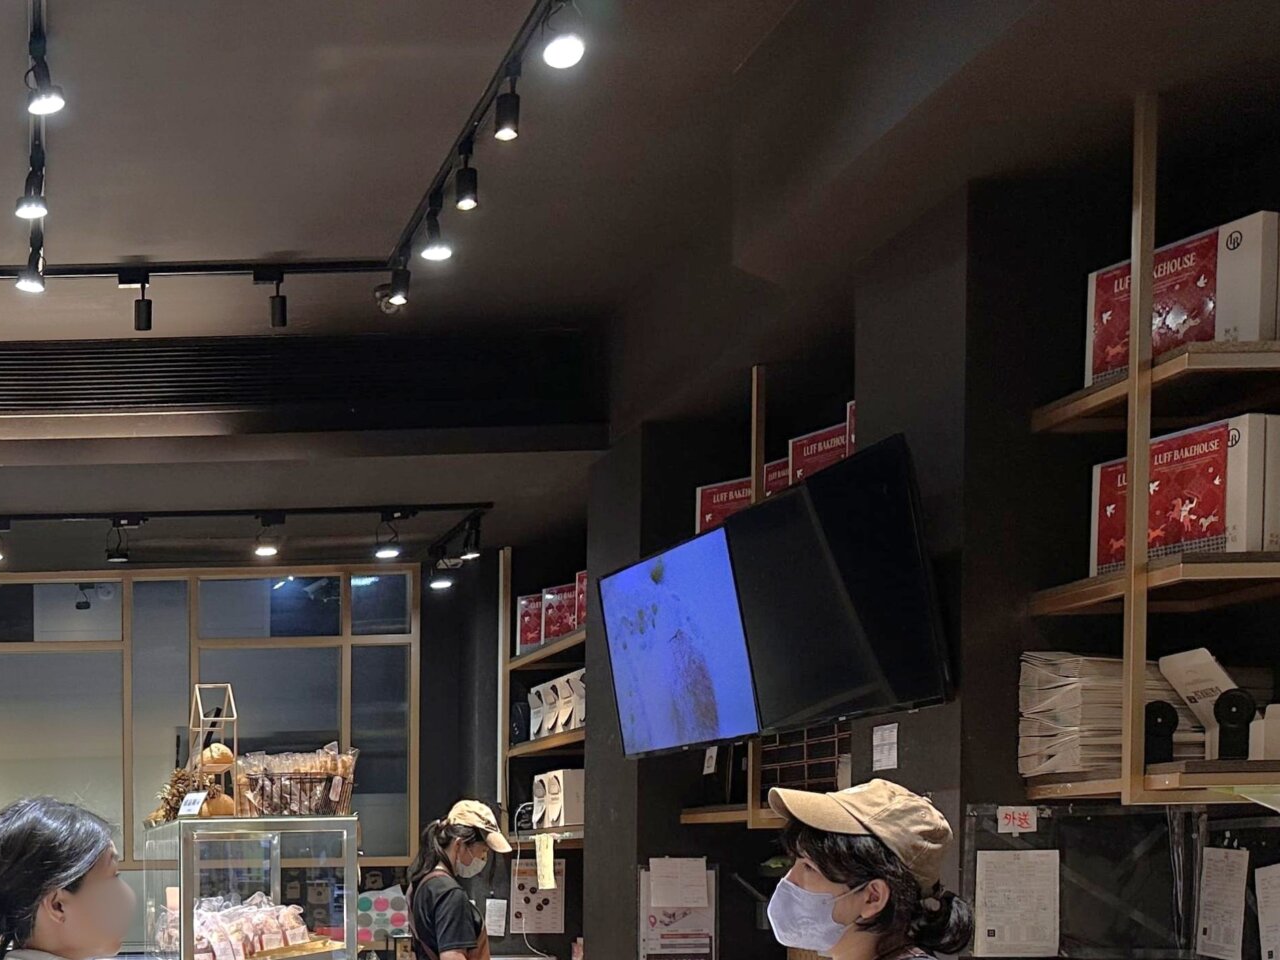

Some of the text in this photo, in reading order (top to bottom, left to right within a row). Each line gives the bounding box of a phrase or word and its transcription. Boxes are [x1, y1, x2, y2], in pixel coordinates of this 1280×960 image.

[1114, 252, 1197, 293] LUF KEHOUSE
[804, 435, 847, 457] LUFF BAKEHOU
[1154, 439, 1220, 466] LUFF BAKEHOUSE
[713, 487, 752, 504] LUFF BAKEH
[1003, 811, 1031, 829] 外送
